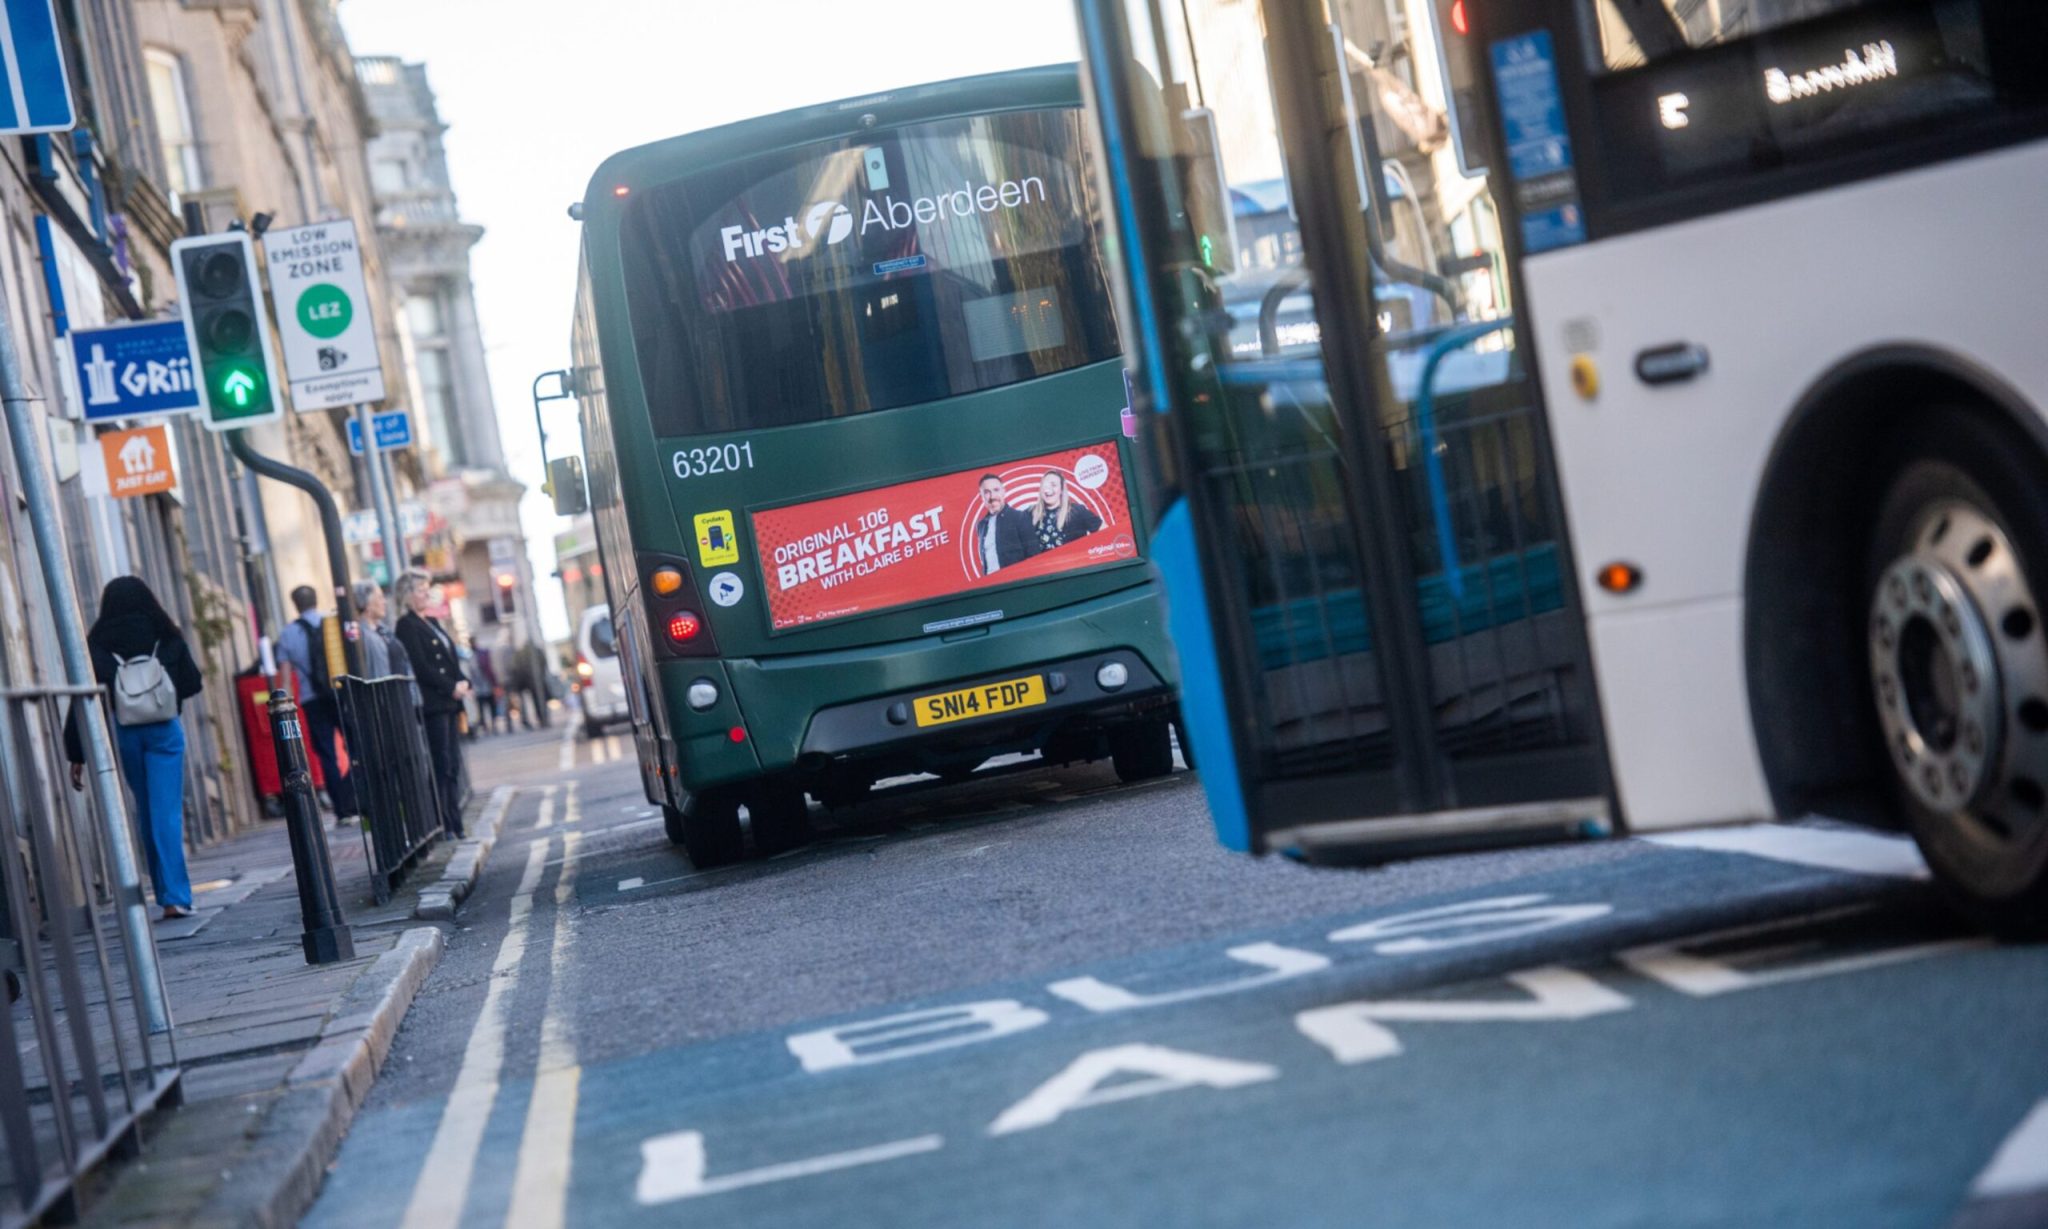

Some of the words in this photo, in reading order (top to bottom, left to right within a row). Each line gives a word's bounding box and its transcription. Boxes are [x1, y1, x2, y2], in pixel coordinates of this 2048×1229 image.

[292, 228, 327, 245] LOW
[721, 217, 802, 262] First
[861, 176, 1046, 235] Aberdeen
[271, 240, 353, 263] EMISSION
[288, 257, 344, 279] ZONE
[308, 301, 342, 321] LEZ
[120, 357, 192, 397] GRii
[672, 440, 754, 479] 63201
[774, 522, 856, 564] ORIGINAL
[856, 508, 889, 533] 106
[777, 505, 943, 591] BREAKFAST
[820, 567, 854, 590] WITH
[856, 549, 902, 577] CLAIRE
[904, 545, 913, 558] &
[915, 530, 950, 554] PETE
[928, 690, 980, 720] SN14
[985, 682, 1029, 710] FDP
[787, 893, 1613, 1074] BUS
